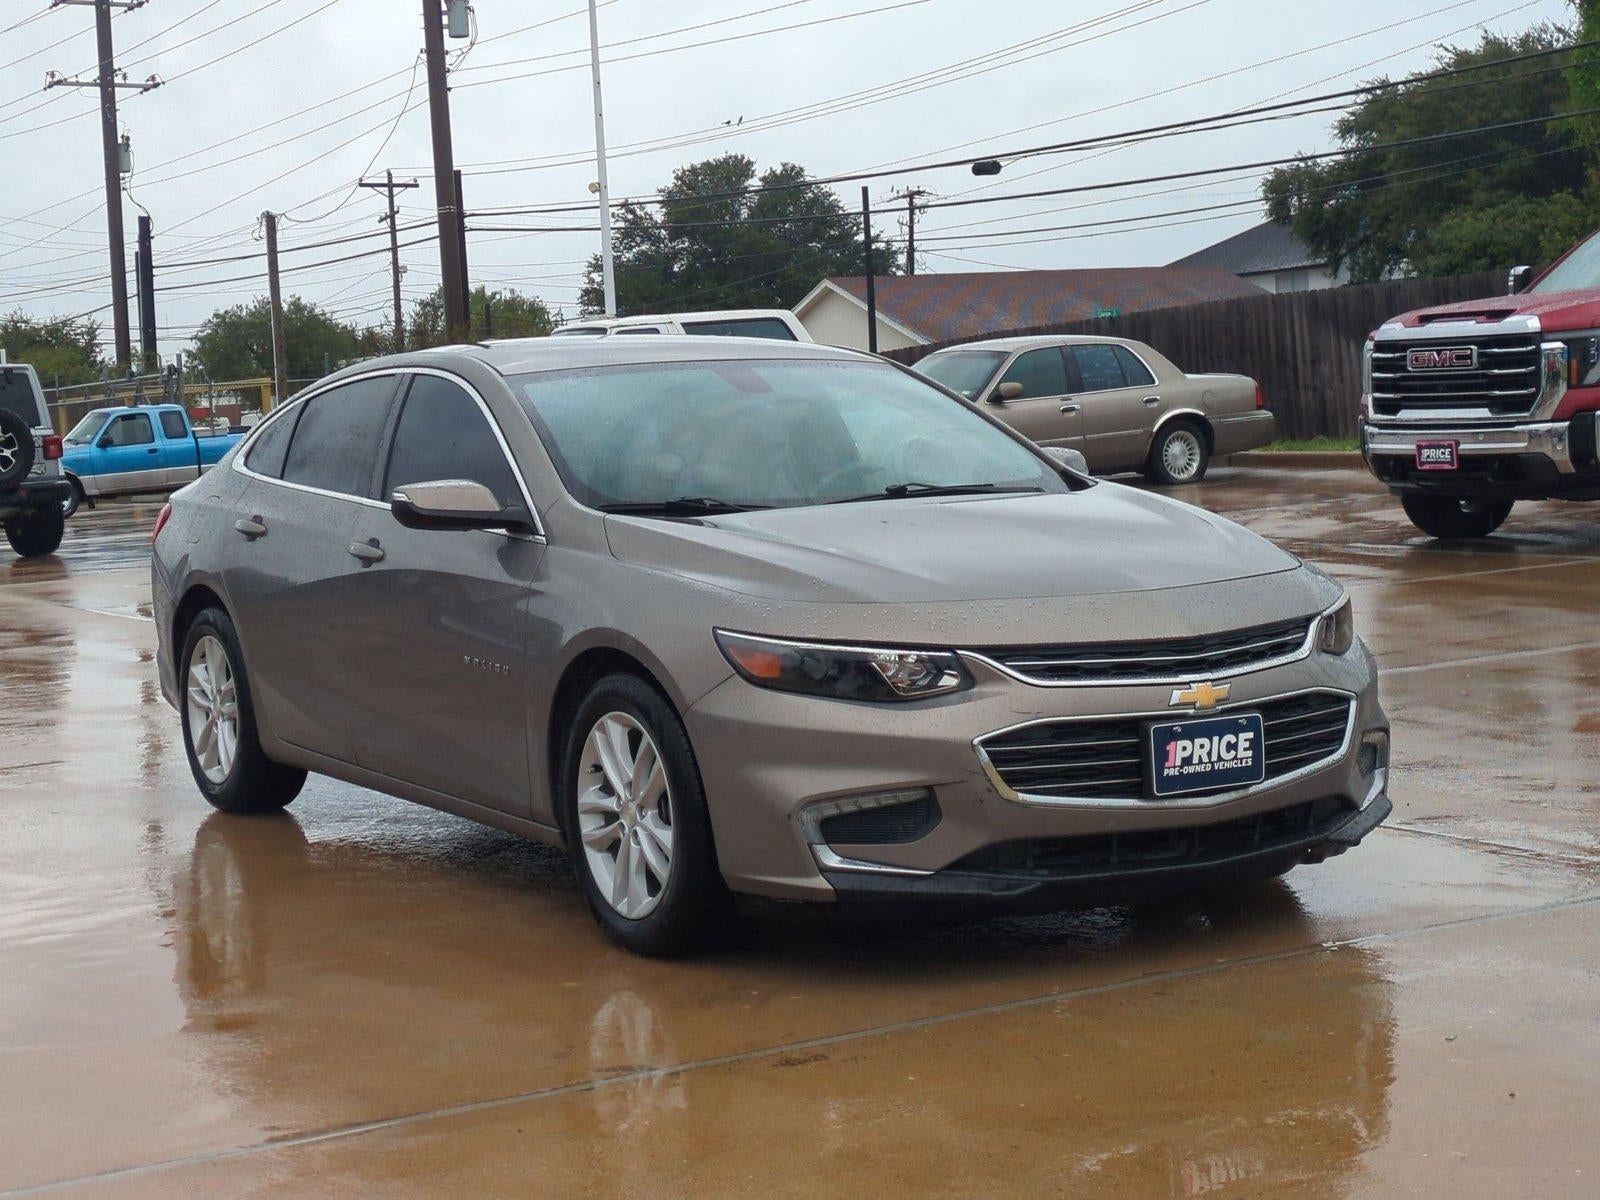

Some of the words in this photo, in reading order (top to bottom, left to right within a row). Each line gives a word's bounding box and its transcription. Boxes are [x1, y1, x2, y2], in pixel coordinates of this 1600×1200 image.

[1410, 349, 1471, 367] GMC
[1164, 732, 1254, 768] 1PRICE
[1163, 763, 1212, 777] PRE-OWNED
[1214, 758, 1252, 771] VEHICLES
